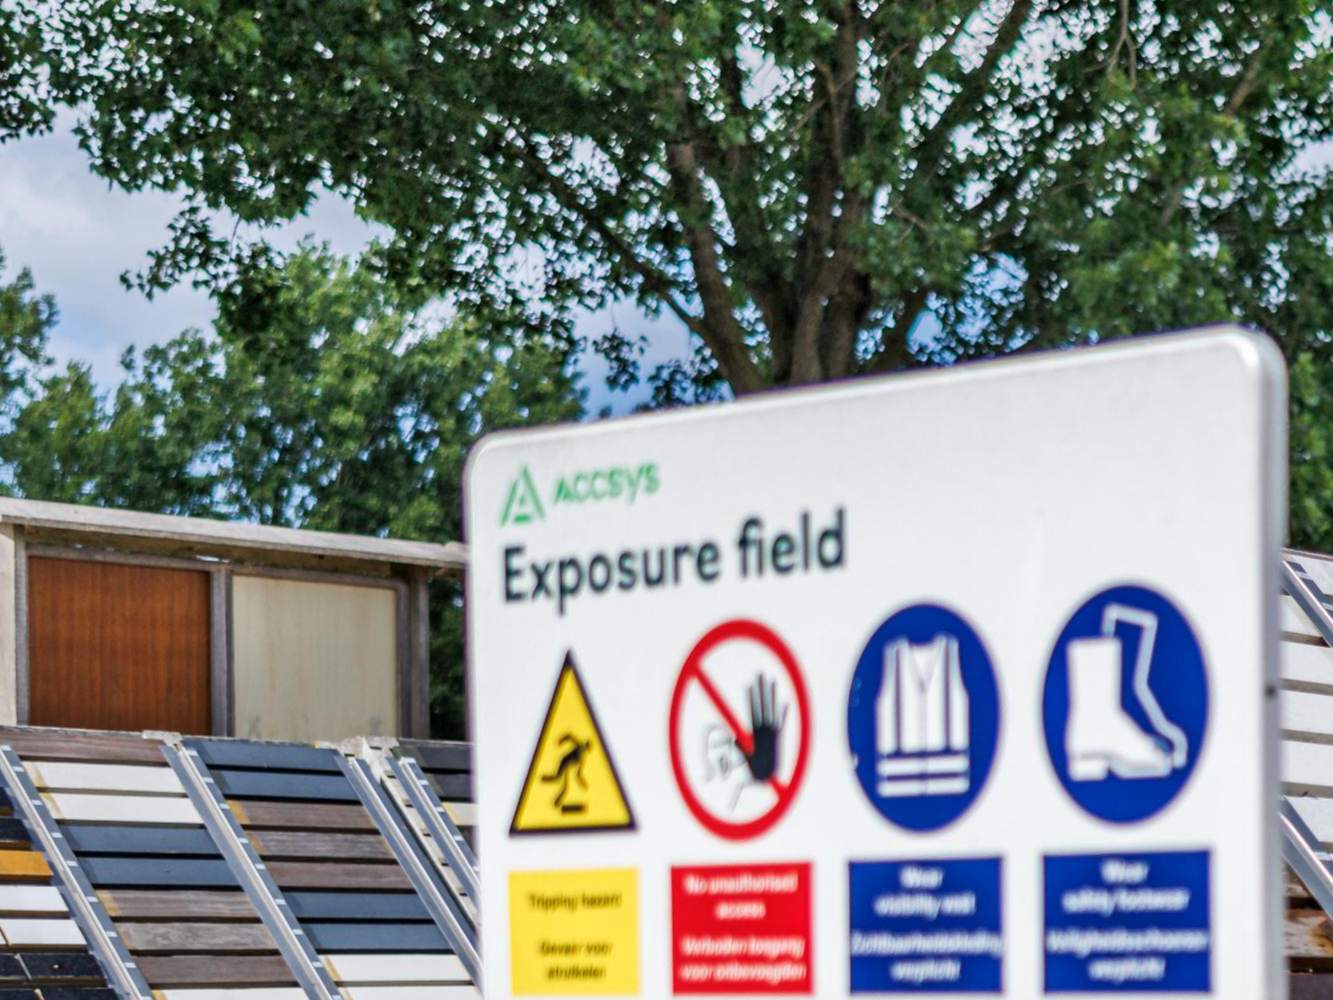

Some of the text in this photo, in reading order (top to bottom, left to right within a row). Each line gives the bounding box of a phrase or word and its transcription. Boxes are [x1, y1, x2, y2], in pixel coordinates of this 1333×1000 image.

[553, 461, 662, 504] ACCSYS
[503, 505, 845, 618] Exposure field
[527, 892, 578, 913] Tripping
